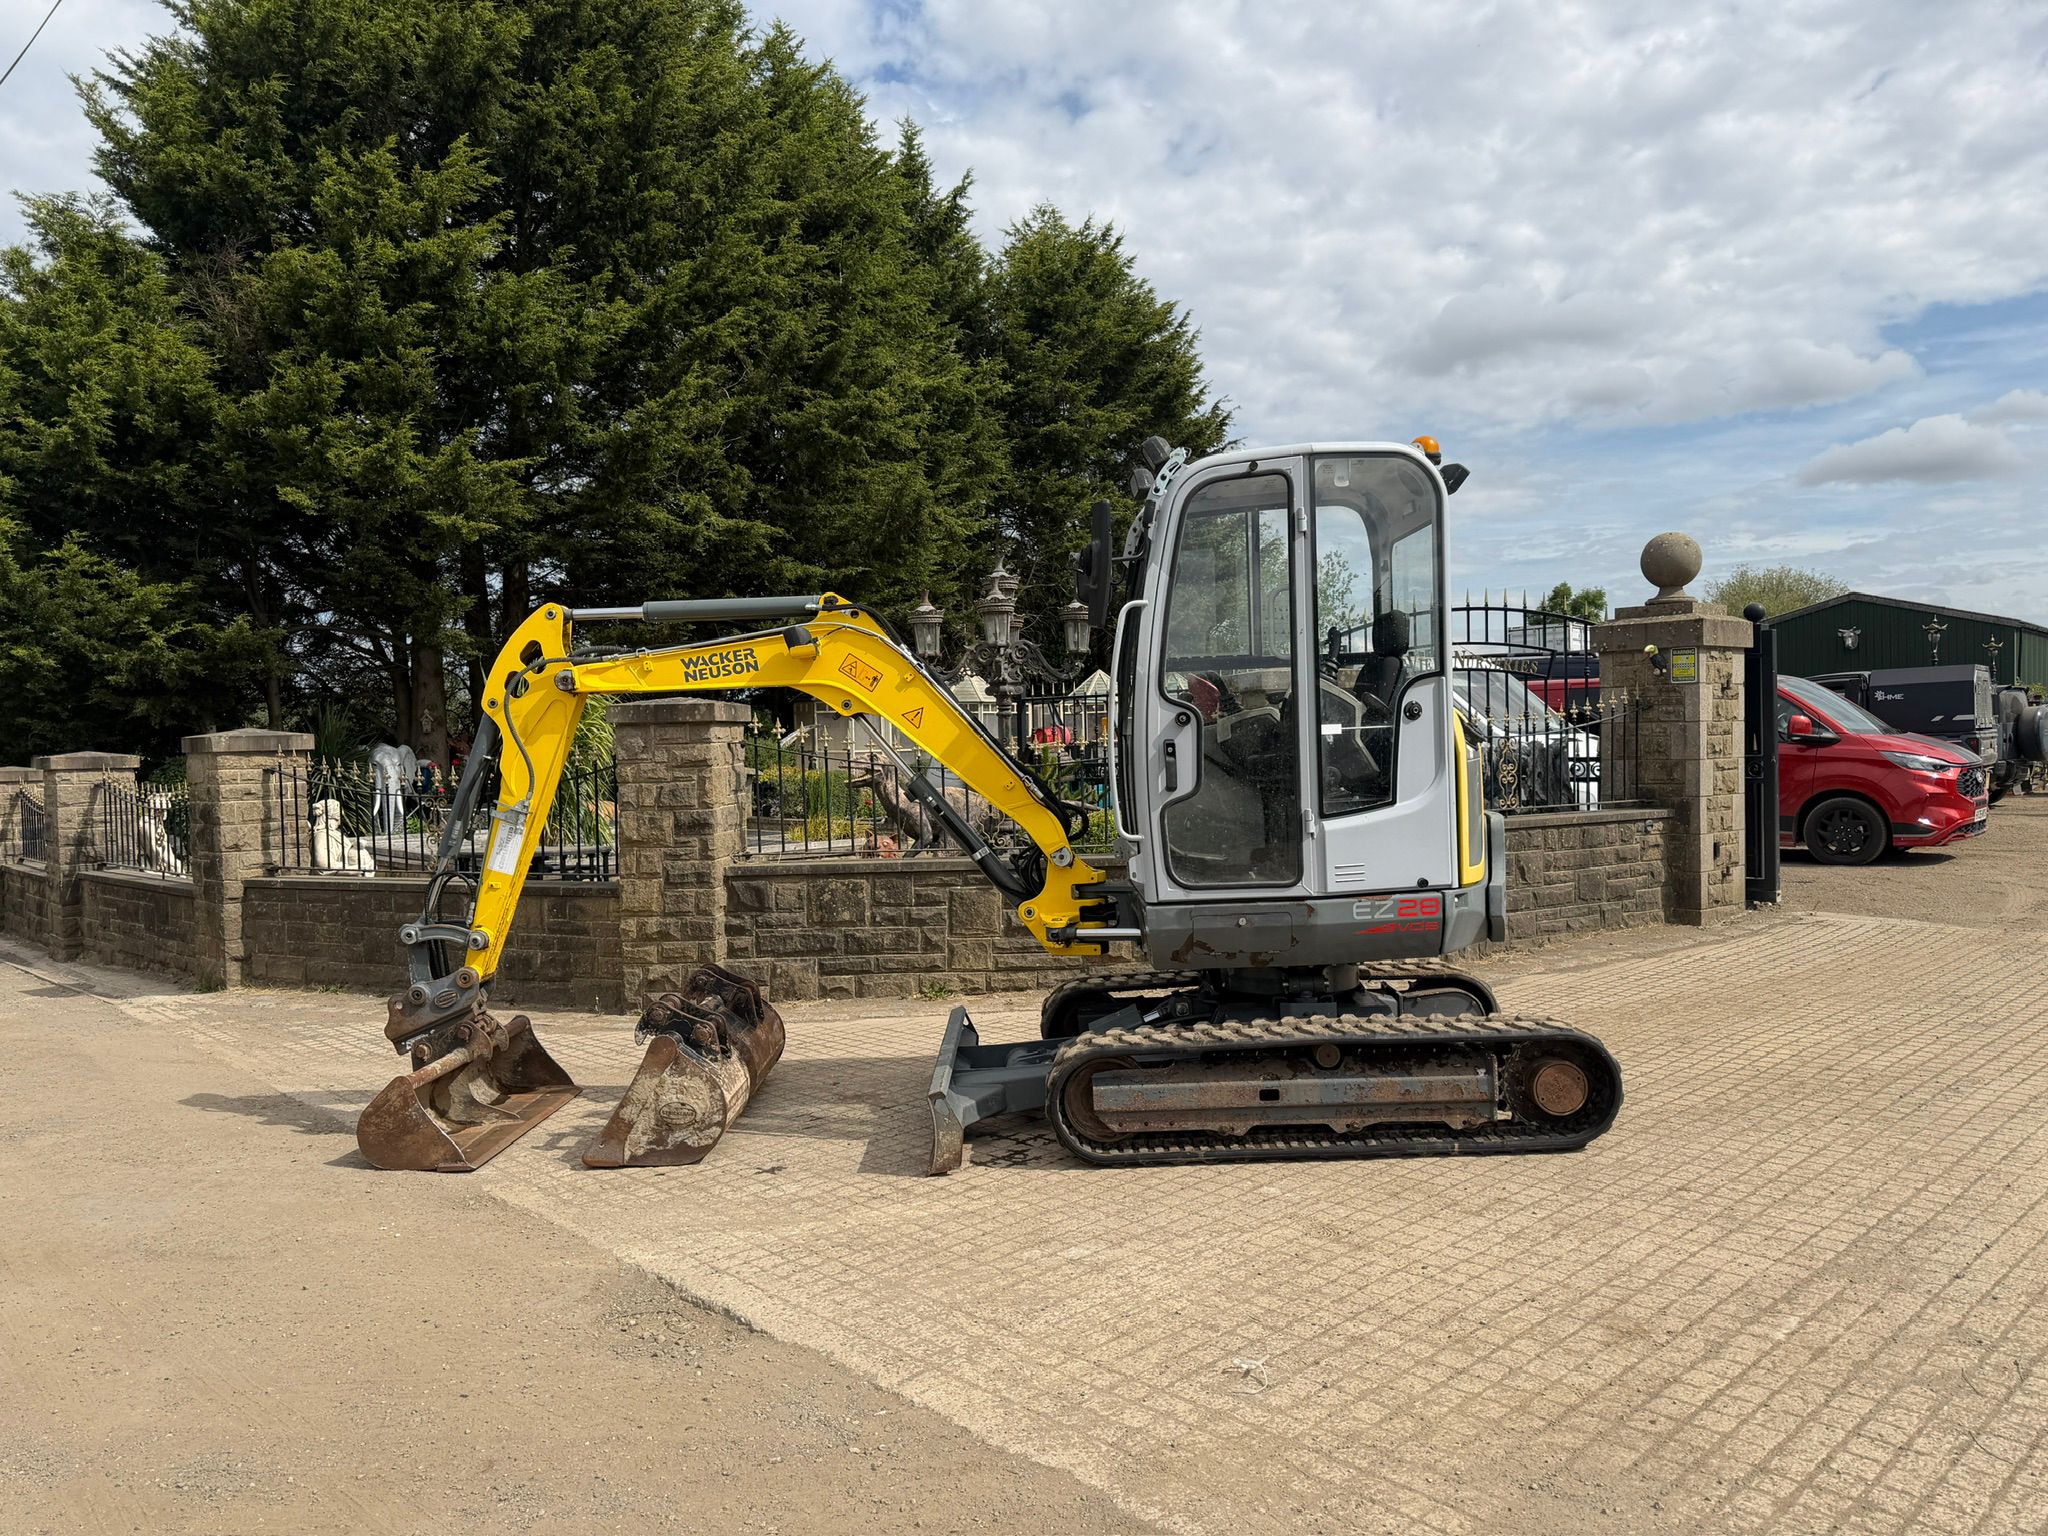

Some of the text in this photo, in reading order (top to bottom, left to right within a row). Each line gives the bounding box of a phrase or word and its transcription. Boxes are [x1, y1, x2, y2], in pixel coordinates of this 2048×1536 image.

[680, 648, 758, 670] WACKER
[683, 661, 759, 682] NEUSON
[1352, 897, 1441, 920] EZ28
